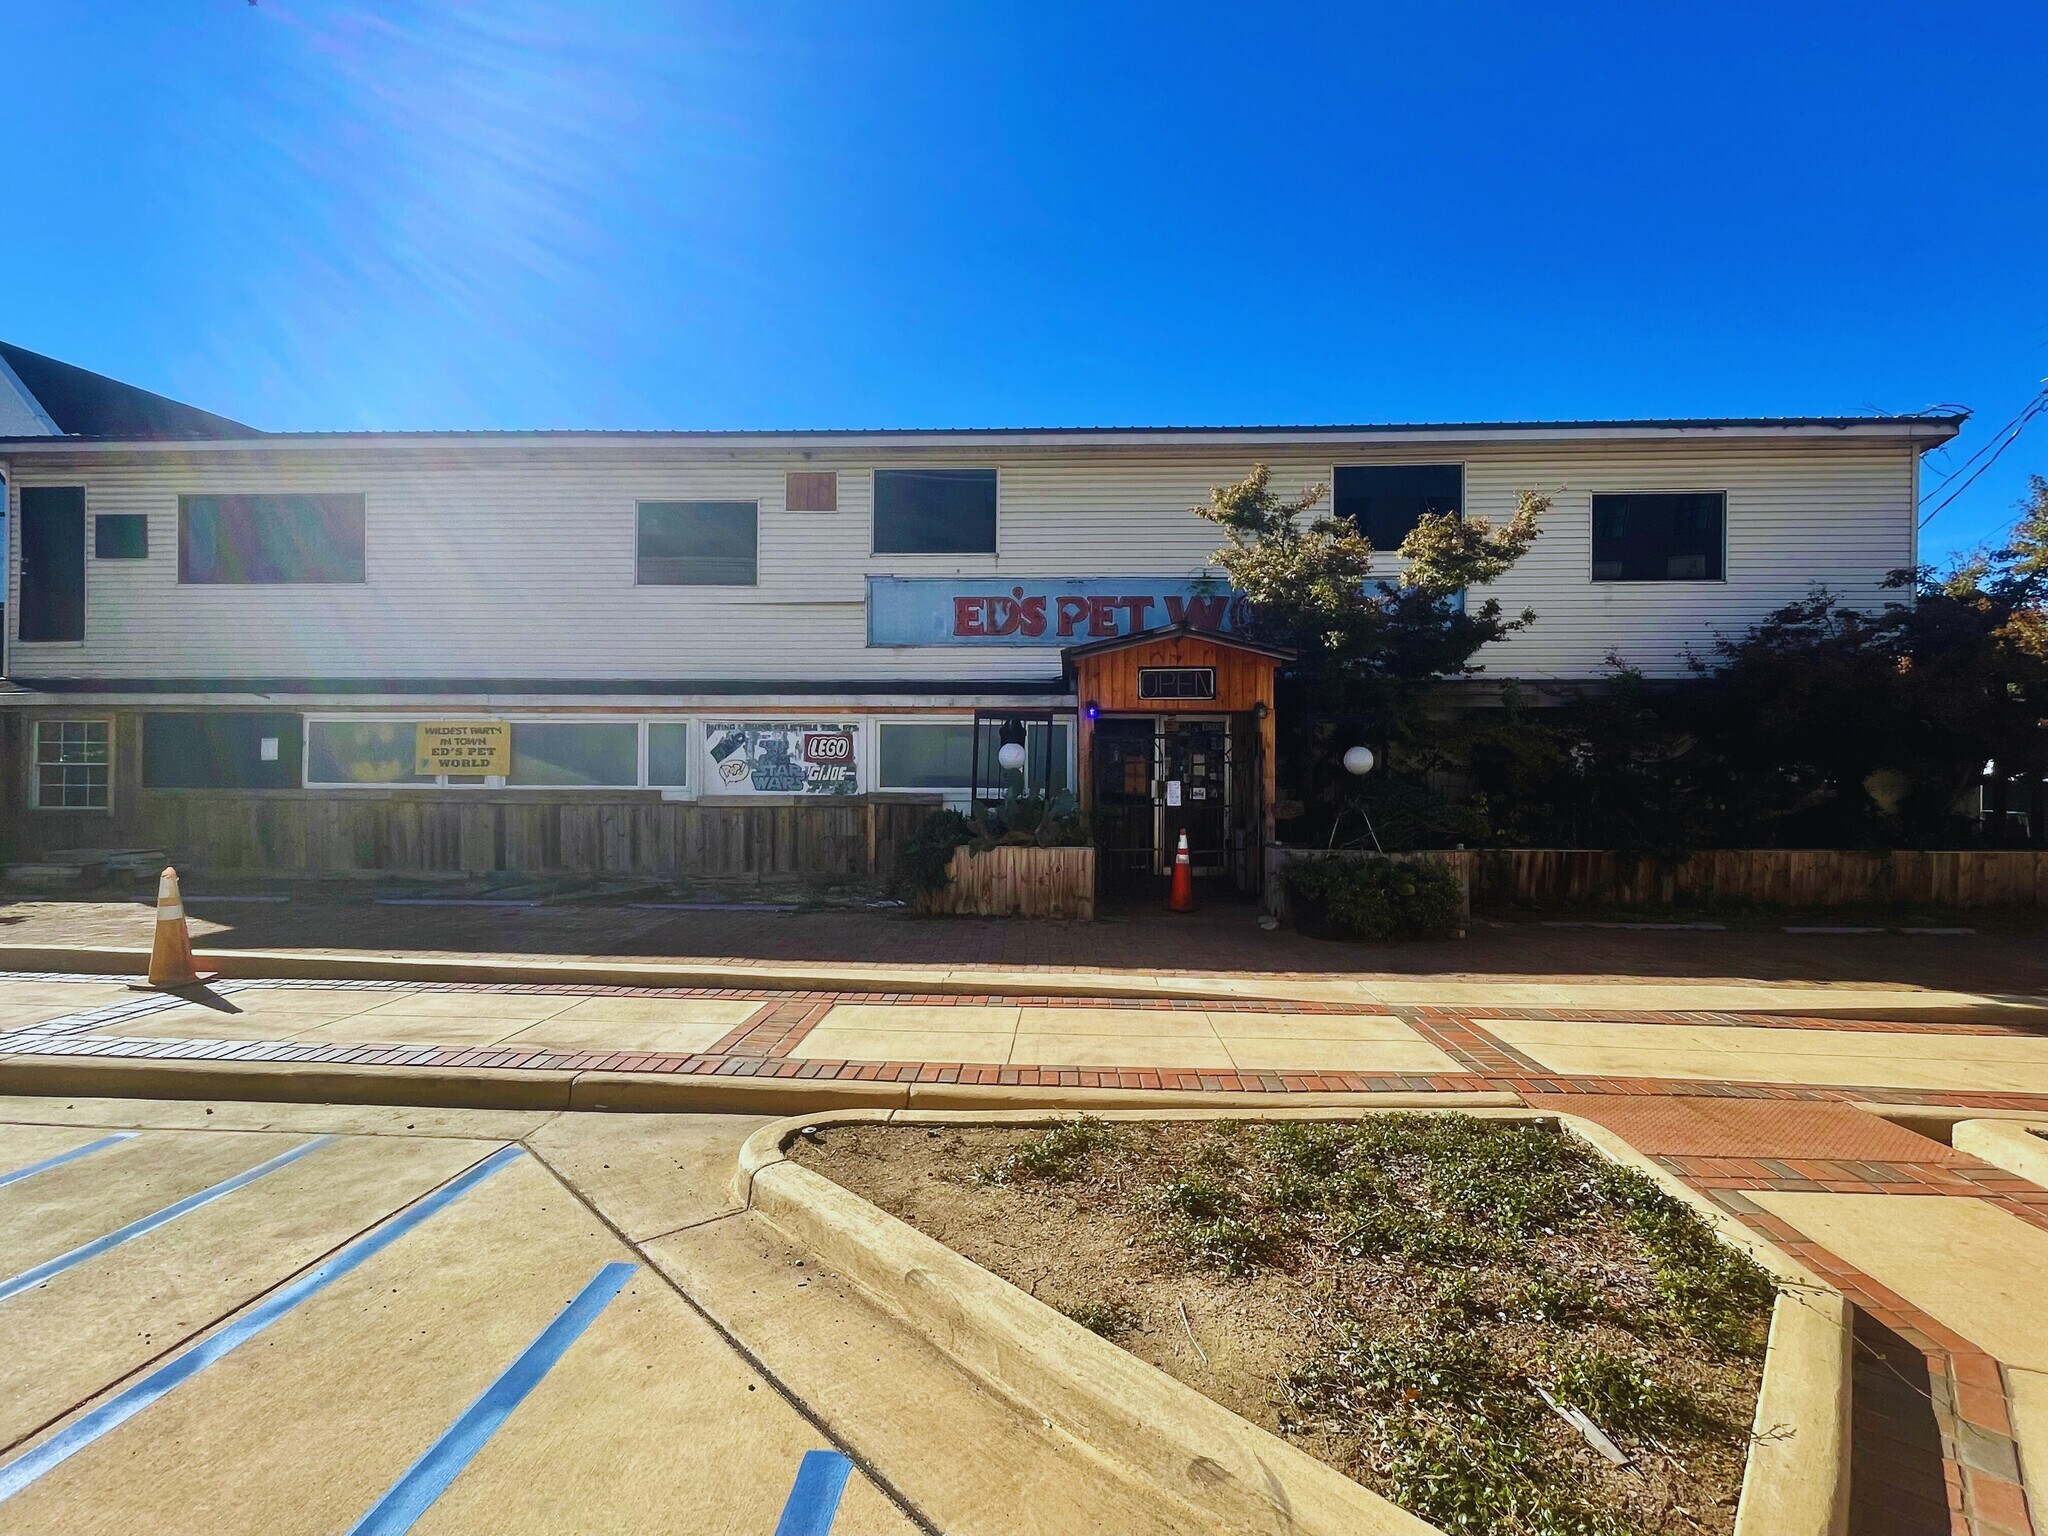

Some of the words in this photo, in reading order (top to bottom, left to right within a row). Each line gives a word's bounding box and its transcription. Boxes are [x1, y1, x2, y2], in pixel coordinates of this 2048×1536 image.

[953, 586, 1047, 636] ED'S
[1055, 596, 1155, 636] PET
[1142, 672, 1210, 696] OPEN
[425, 727, 467, 735] WILDEST
[440, 738, 451, 746] IN
[454, 738, 487, 746] TOWN
[431, 747, 463, 756] ED'S
[467, 747, 496, 756] PET
[810, 739, 847, 757] LEGO
[438, 759, 491, 768] WORLD
[754, 777, 803, 790] WARS
